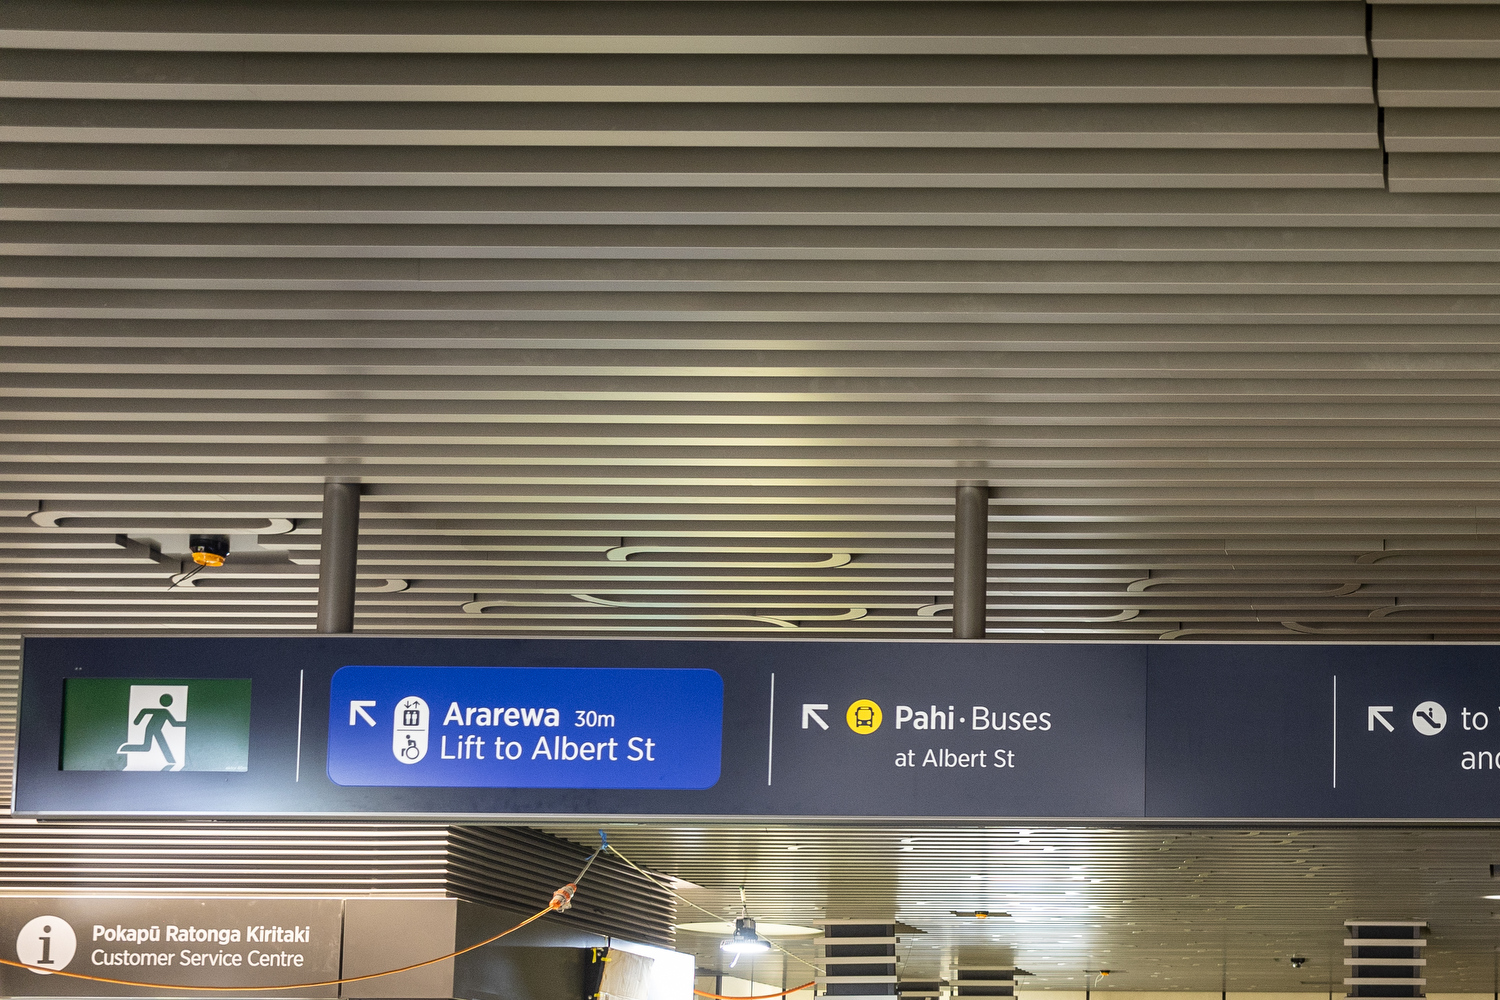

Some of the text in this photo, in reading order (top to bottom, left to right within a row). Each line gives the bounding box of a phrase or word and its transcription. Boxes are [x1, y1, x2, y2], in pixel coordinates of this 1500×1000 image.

[443, 701, 616, 729] Ararewa 30m
[1461, 707, 1489, 731] to
[440, 734, 656, 762] Lift to Albert St
[895, 748, 1015, 768] at Albert St
[92, 923, 310, 946] Pokapū Ratonga Kiritaki
[91, 948, 304, 967] Customer Service Centre
